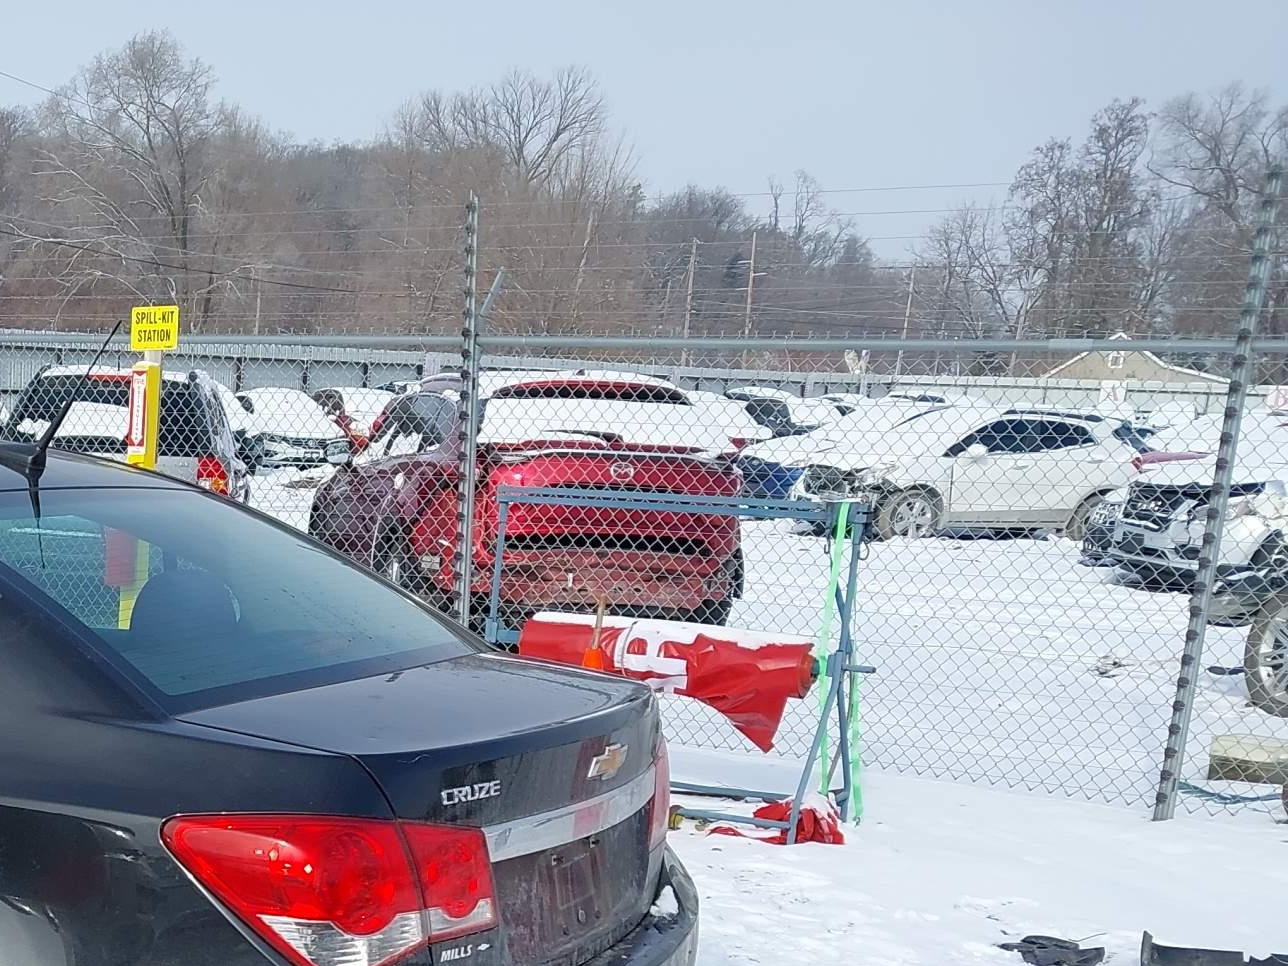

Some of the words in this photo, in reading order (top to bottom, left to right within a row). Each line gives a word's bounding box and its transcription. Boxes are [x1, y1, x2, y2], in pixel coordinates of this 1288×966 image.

[135, 311, 175, 325] SPILL-KIT
[137, 329, 171, 342] STATION
[441, 780, 501, 806] CRUZE
[440, 944, 473, 962] MILLS
